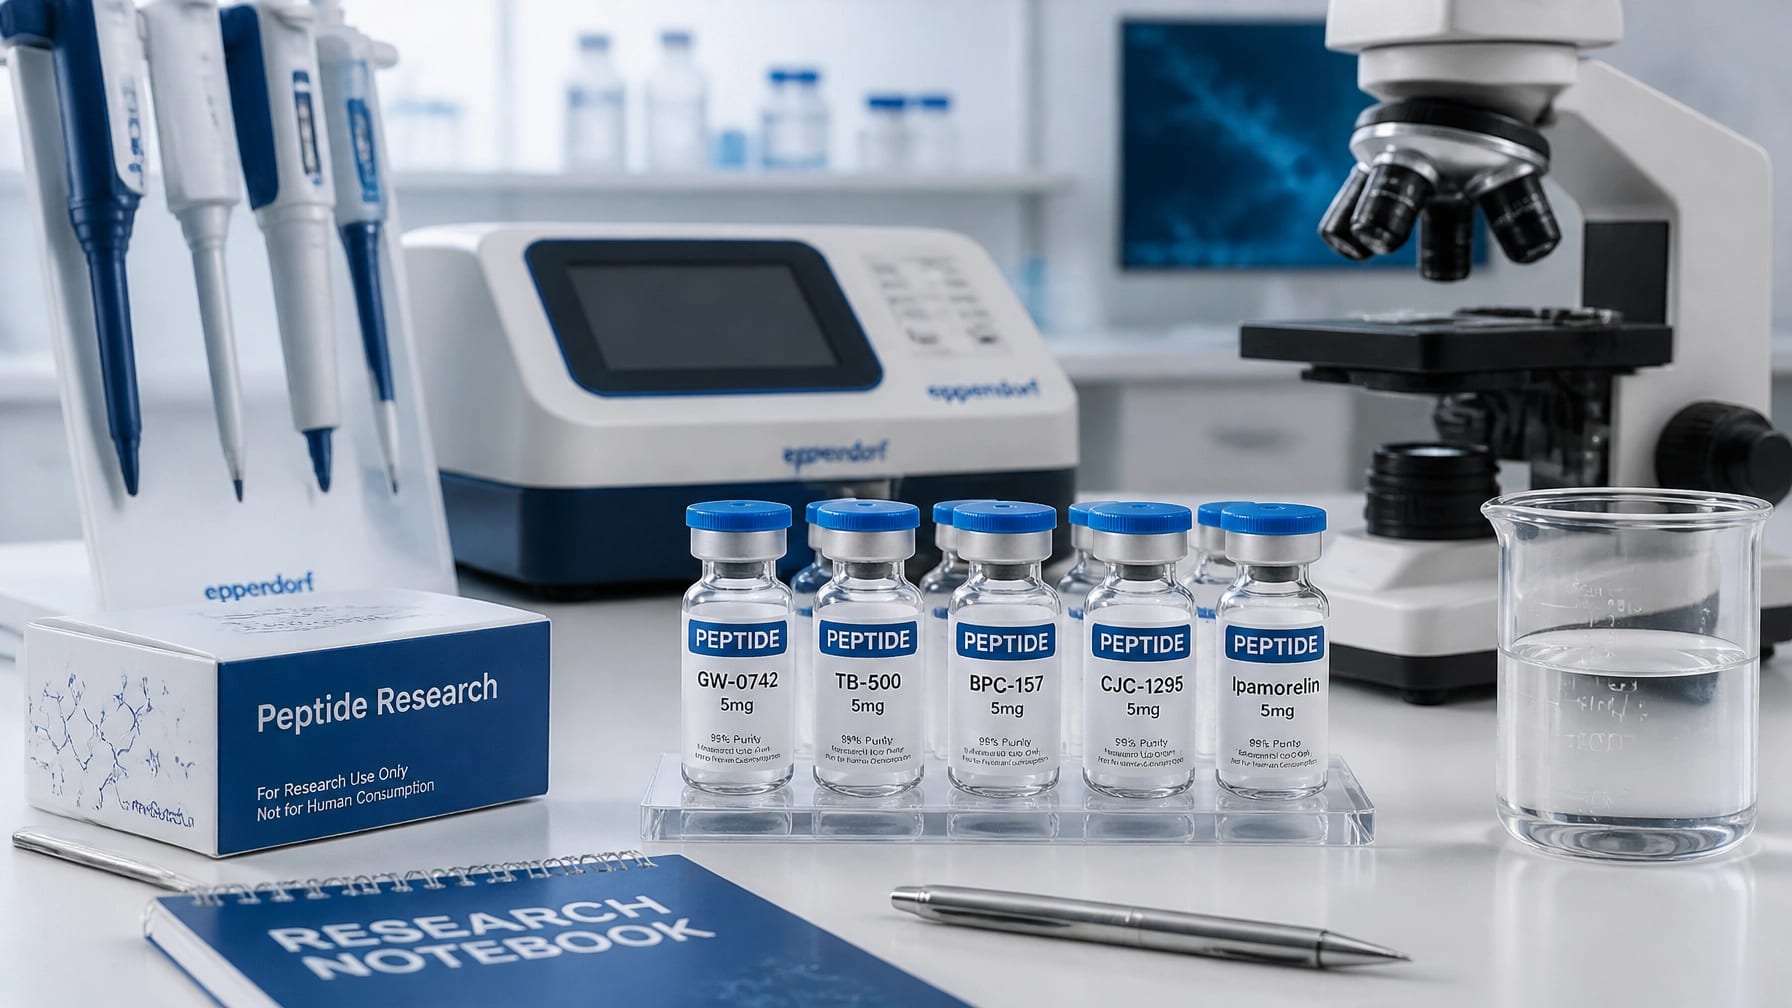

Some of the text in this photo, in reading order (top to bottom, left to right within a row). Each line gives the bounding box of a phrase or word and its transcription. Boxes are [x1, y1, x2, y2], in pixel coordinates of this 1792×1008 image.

[696, 628, 780, 650] PEPTIDE
[827, 629, 911, 650] PEPTIDE
[964, 631, 1049, 653] PEPTIDE
[1100, 632, 1184, 654] PEPTIDE
[1234, 634, 1318, 656] PEPTIDE
[697, 671, 779, 690] GW-0742
[835, 673, 902, 691] TB-500
[969, 675, 1045, 694] BPC-157
[1100, 675, 1184, 694] CJC-1295
[1232, 676, 1320, 697] Ipamorelin
[257, 672, 498, 735] Peptide Research
[720, 698, 754, 715] 5mg
[851, 699, 885, 716] 5mg
[990, 701, 1024, 719] 5mg
[1126, 702, 1161, 720] 5mg
[1260, 704, 1295, 721] 5mg
[257, 764, 409, 801] For Research Use Only
[257, 779, 435, 821] Not for Human Consumption
[268, 895, 672, 953] RESEARCH
[302, 918, 717, 981] NOTEBOOK
